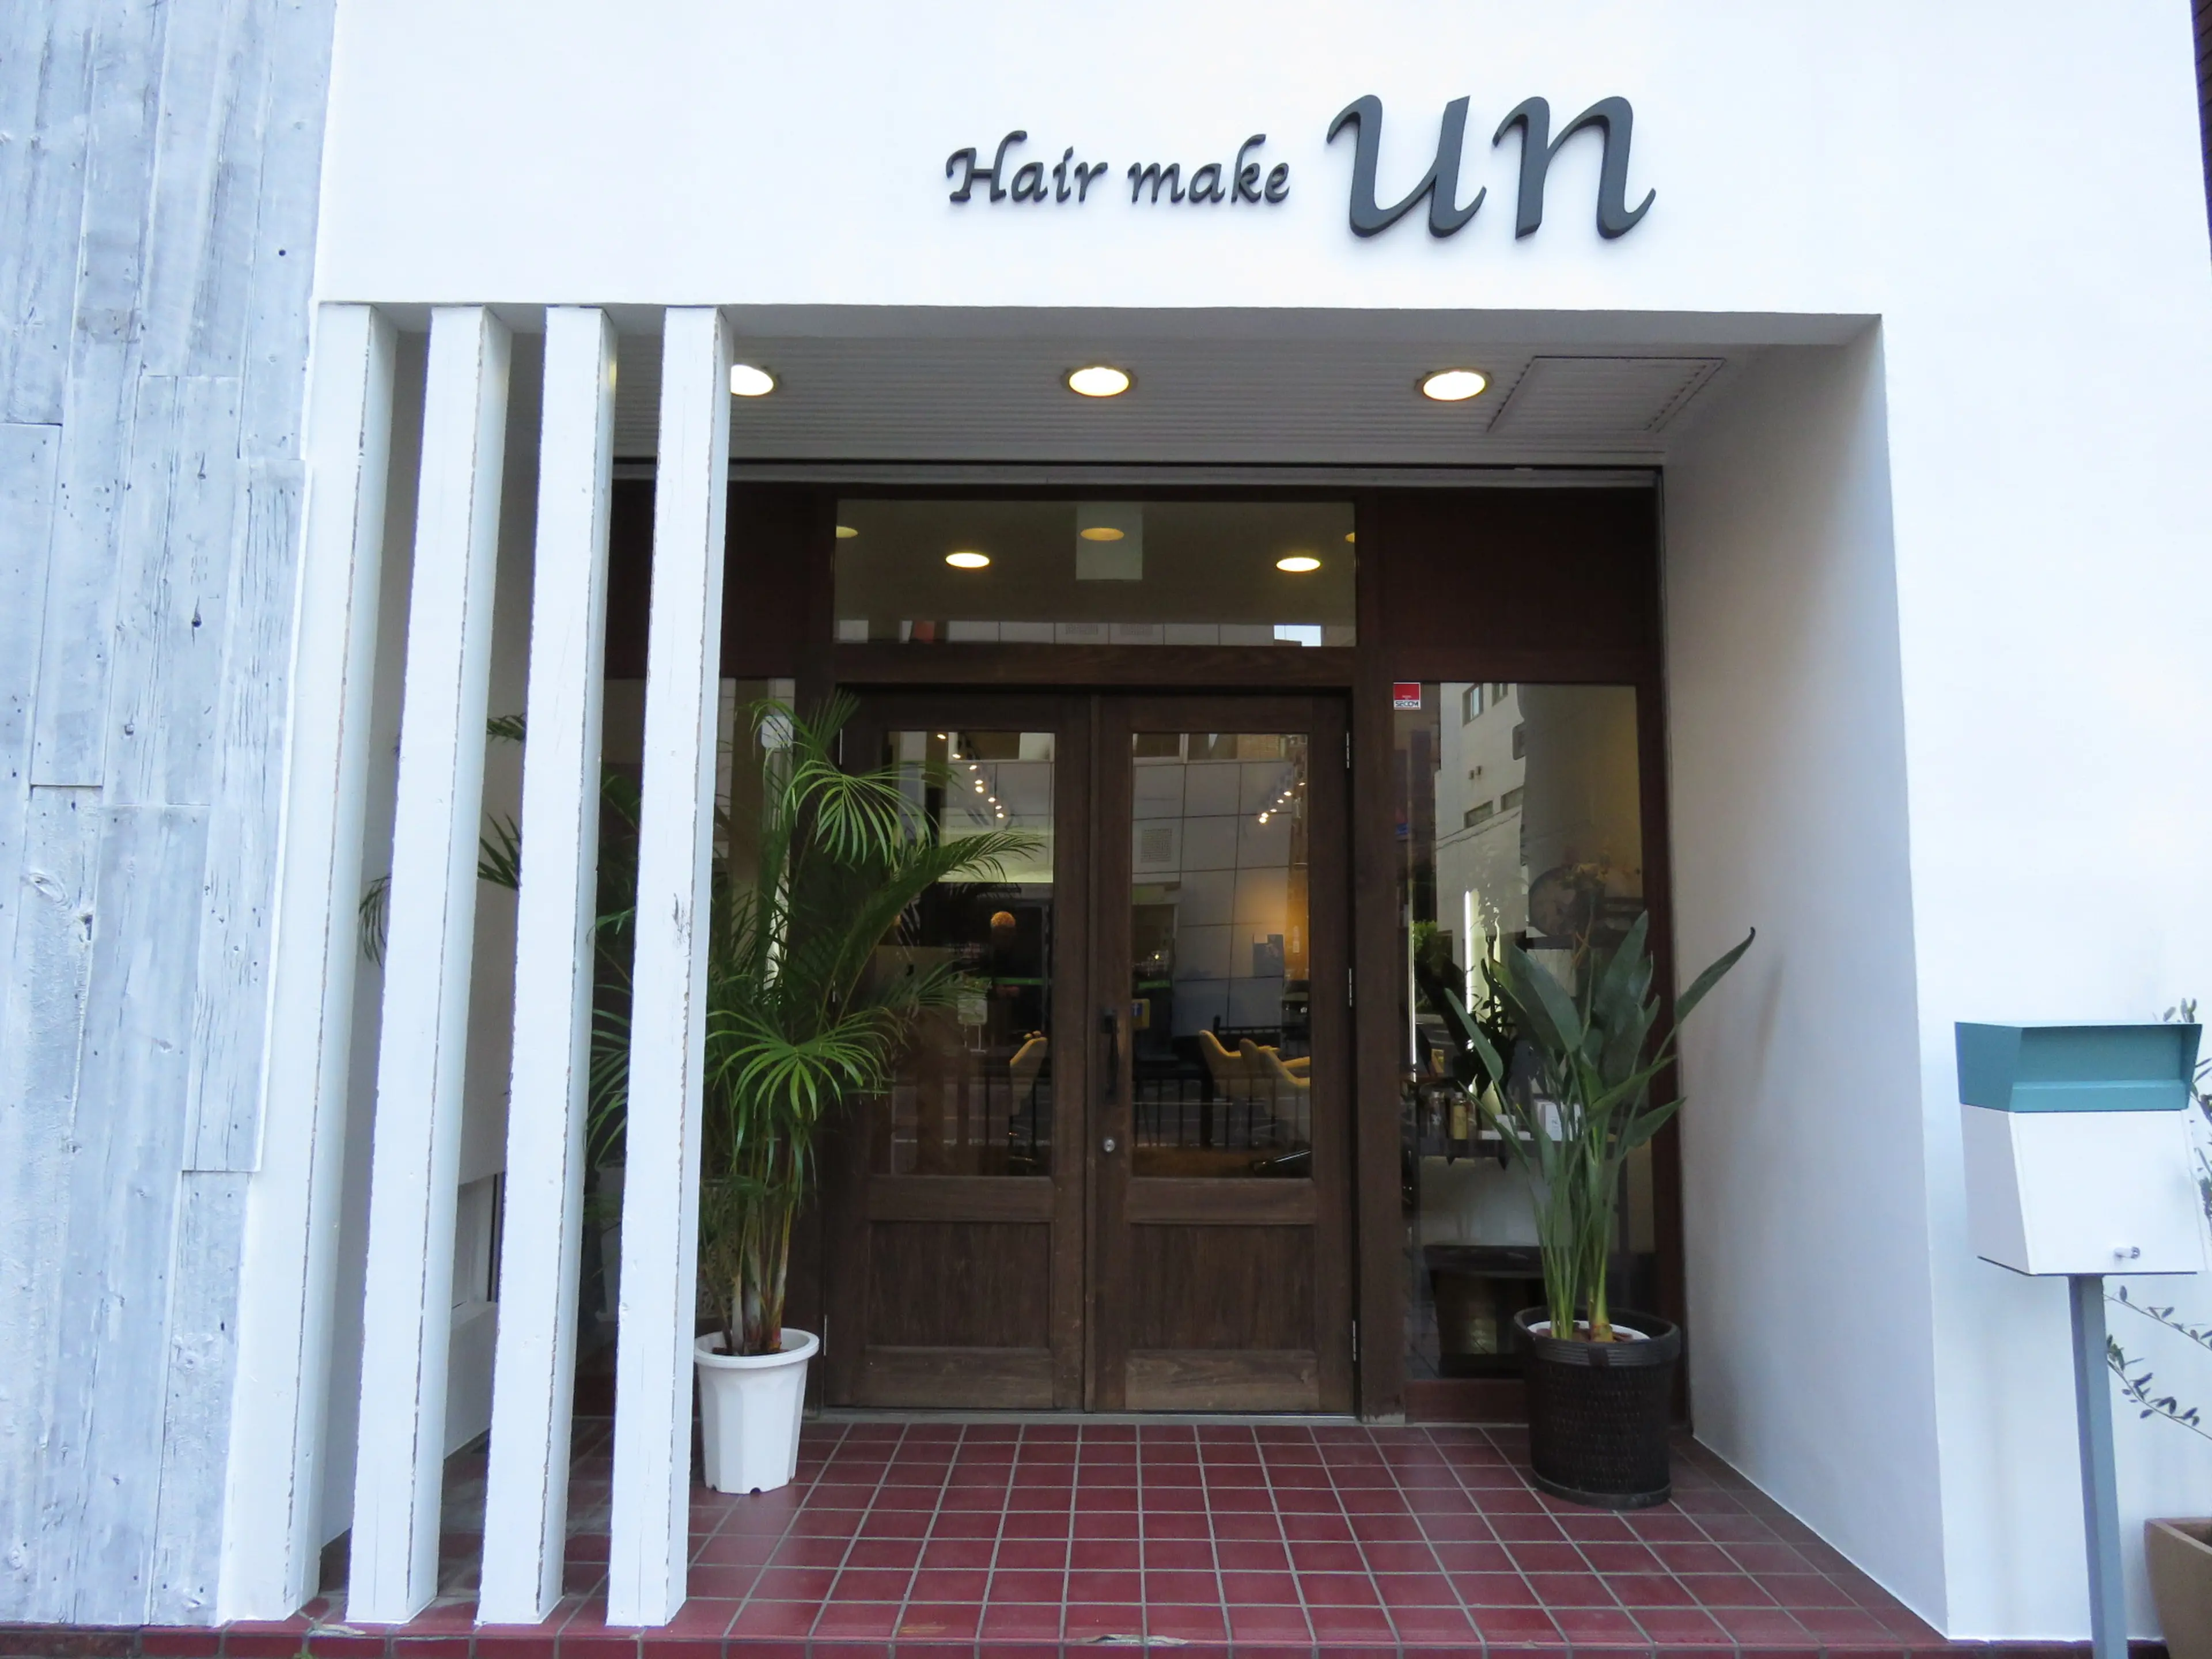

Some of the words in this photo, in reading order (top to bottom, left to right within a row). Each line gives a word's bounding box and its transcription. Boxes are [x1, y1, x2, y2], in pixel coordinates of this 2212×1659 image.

[945, 130, 1108, 204] Hair
[1127, 134, 1290, 205] make
[1325, 94, 1656, 242] un
